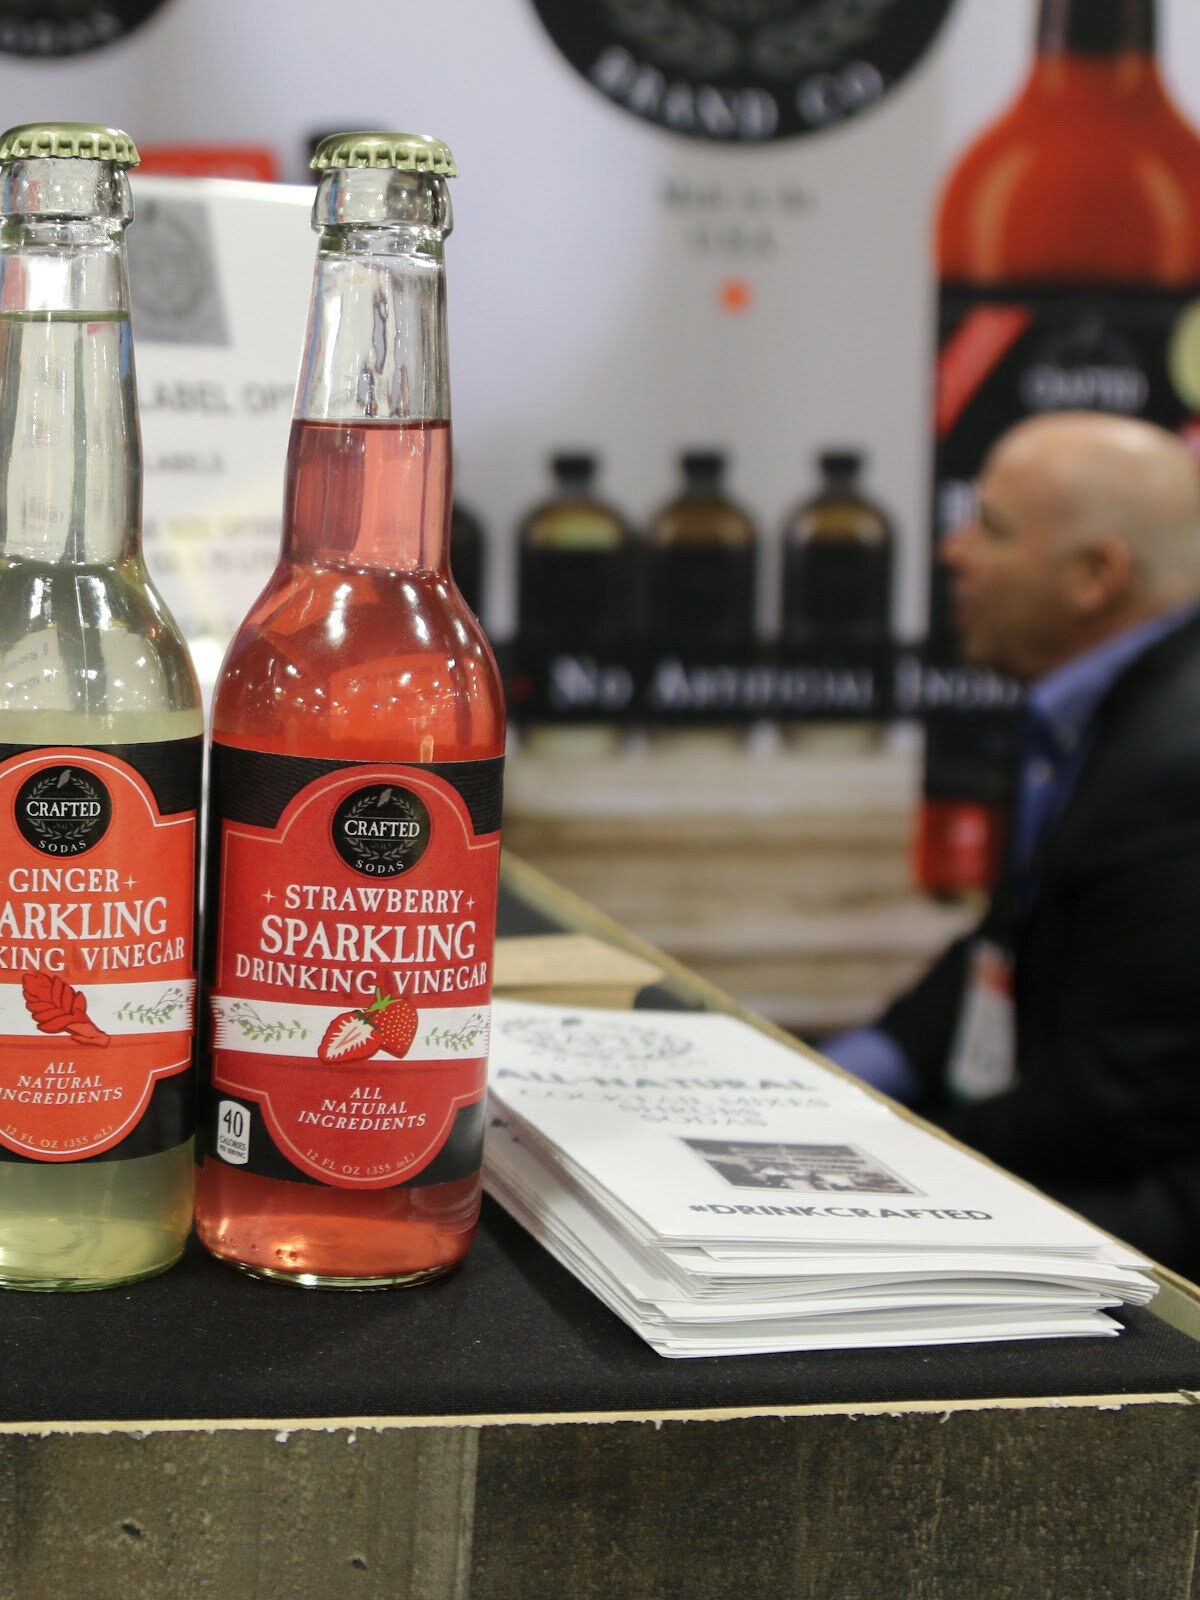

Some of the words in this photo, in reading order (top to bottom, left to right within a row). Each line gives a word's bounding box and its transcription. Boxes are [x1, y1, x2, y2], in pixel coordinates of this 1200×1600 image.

[26, 801, 101, 817] CRAFTED
[344, 820, 420, 837] CRAFTED
[39, 840, 87, 853] SODAS
[356, 860, 404, 874] SODAS
[8, 868, 120, 893] GINGER
[285, 884, 464, 914] STRAWBERRY
[260, 914, 476, 963] SPARKLING
[80, 937, 185, 971] VINEGAR
[236, 954, 377, 995] DRINKING
[393, 962, 487, 995] VINEGAR
[44, 1062, 76, 1075] ALL
[17, 1075, 103, 1089] NATURAL
[350, 1087, 382, 1099] ALL
[321, 1099, 408, 1115] NATURAL
[223, 1109, 243, 1137] 40
[298, 1111, 427, 1131] INGREDIENTS
[5, 1124, 17, 1136] 12
[20, 1134, 35, 1146] FL
[40, 1138, 58, 1149] OZ
[64, 1136, 88, 1149] (355
[220, 1135, 246, 1152] CALORIES
[306, 1149, 318, 1161] 12
[322, 1158, 336, 1170] FL
[342, 1164, 360, 1175] OZ
[367, 1162, 391, 1175] (355
[688, 1203, 994, 1221] #DRINKCRAFTED
